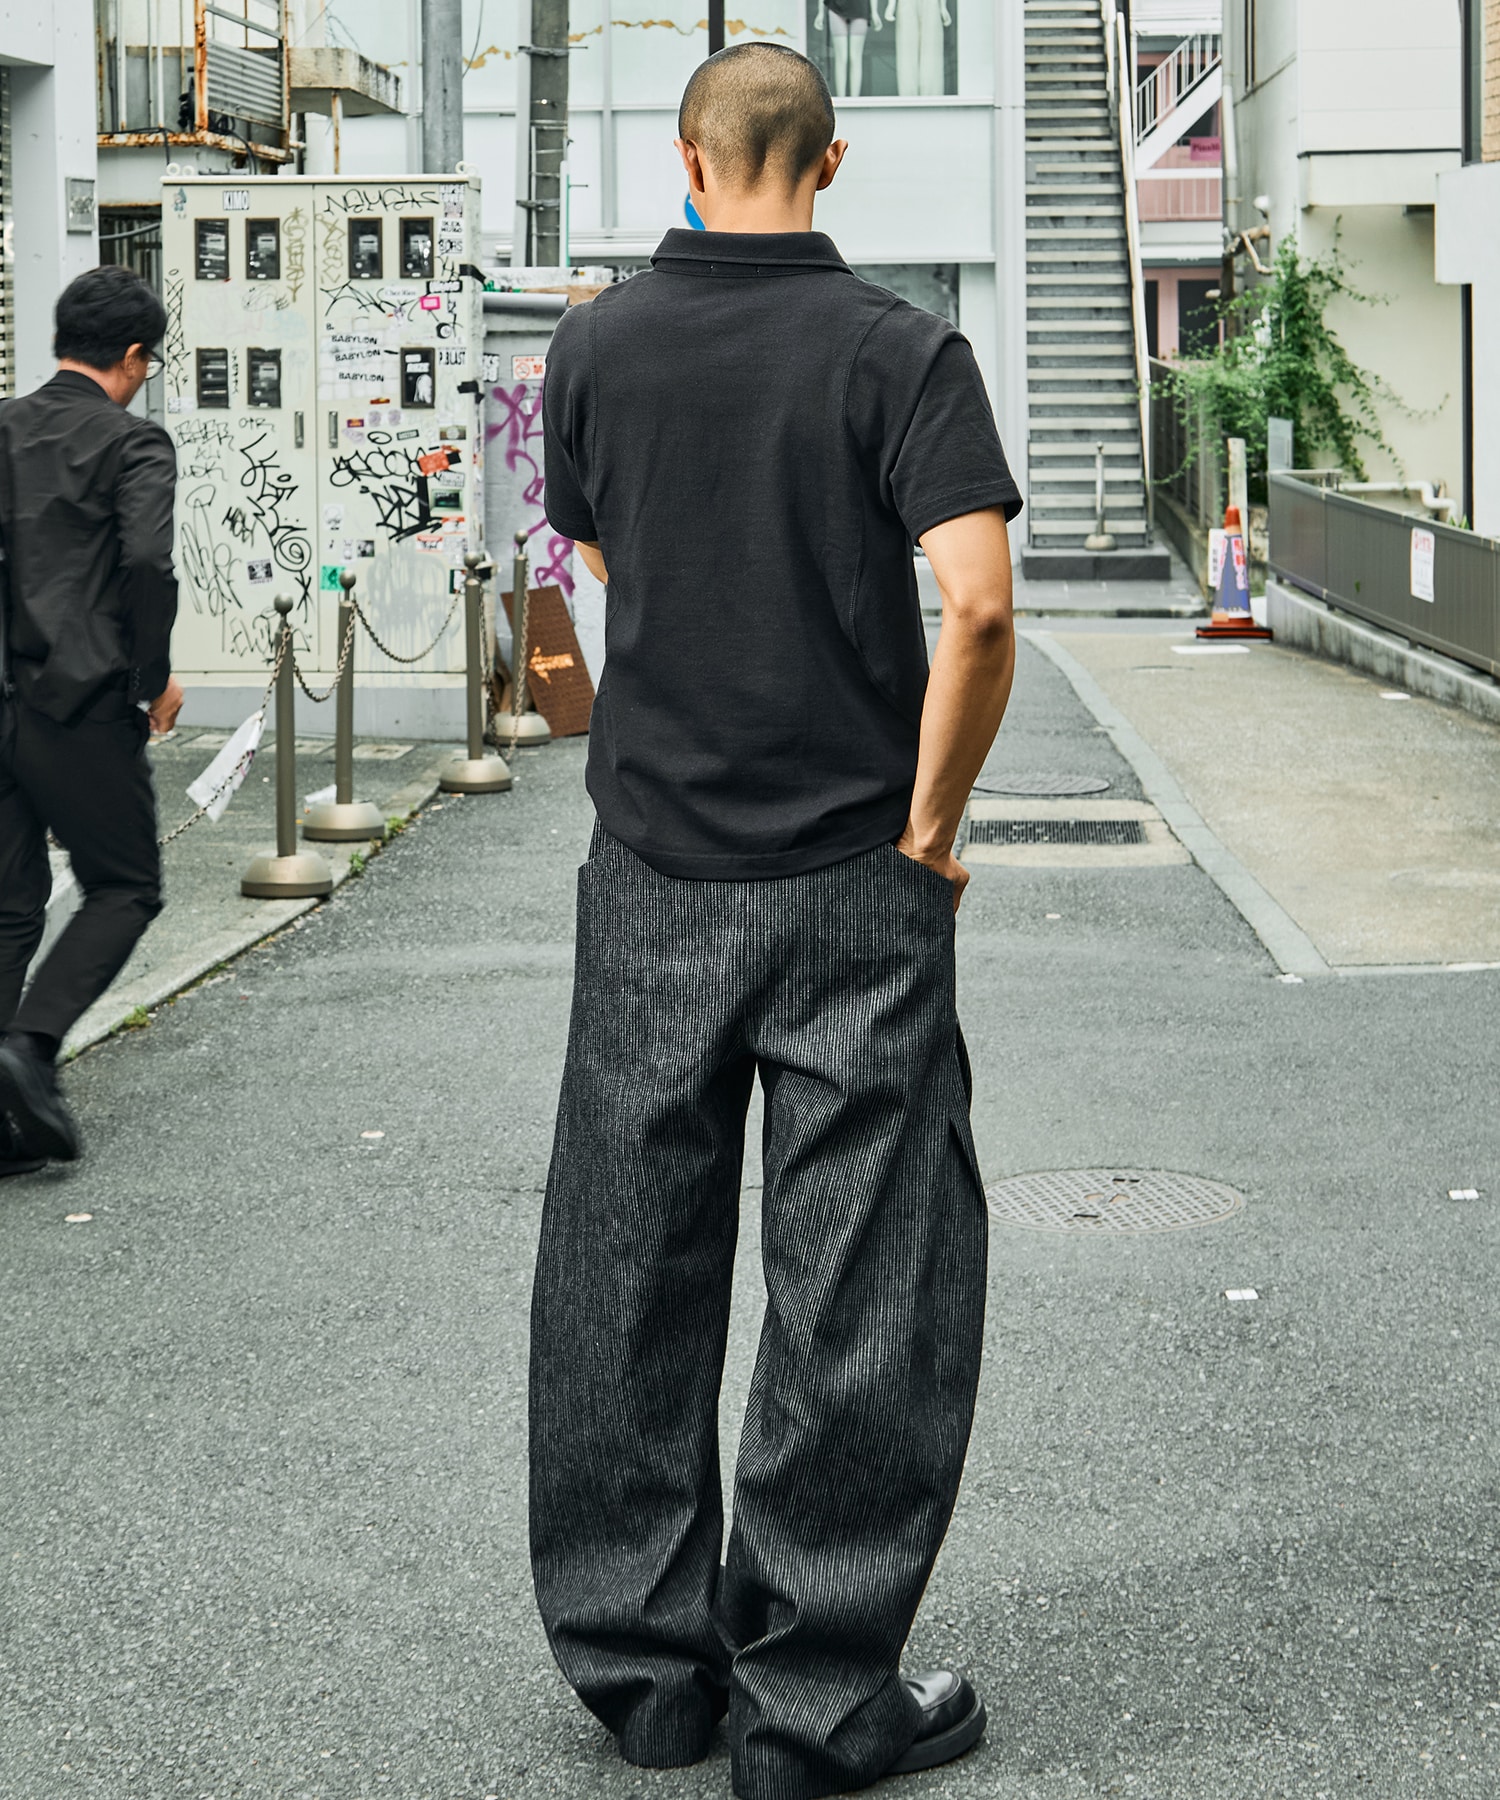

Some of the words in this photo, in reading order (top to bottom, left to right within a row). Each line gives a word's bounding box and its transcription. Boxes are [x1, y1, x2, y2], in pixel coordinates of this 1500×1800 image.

[223, 191, 249, 210] KIMO
[331, 336, 378, 345] BABYLON
[335, 350, 381, 362] BABYLON
[338, 372, 385, 383] BABYLON
